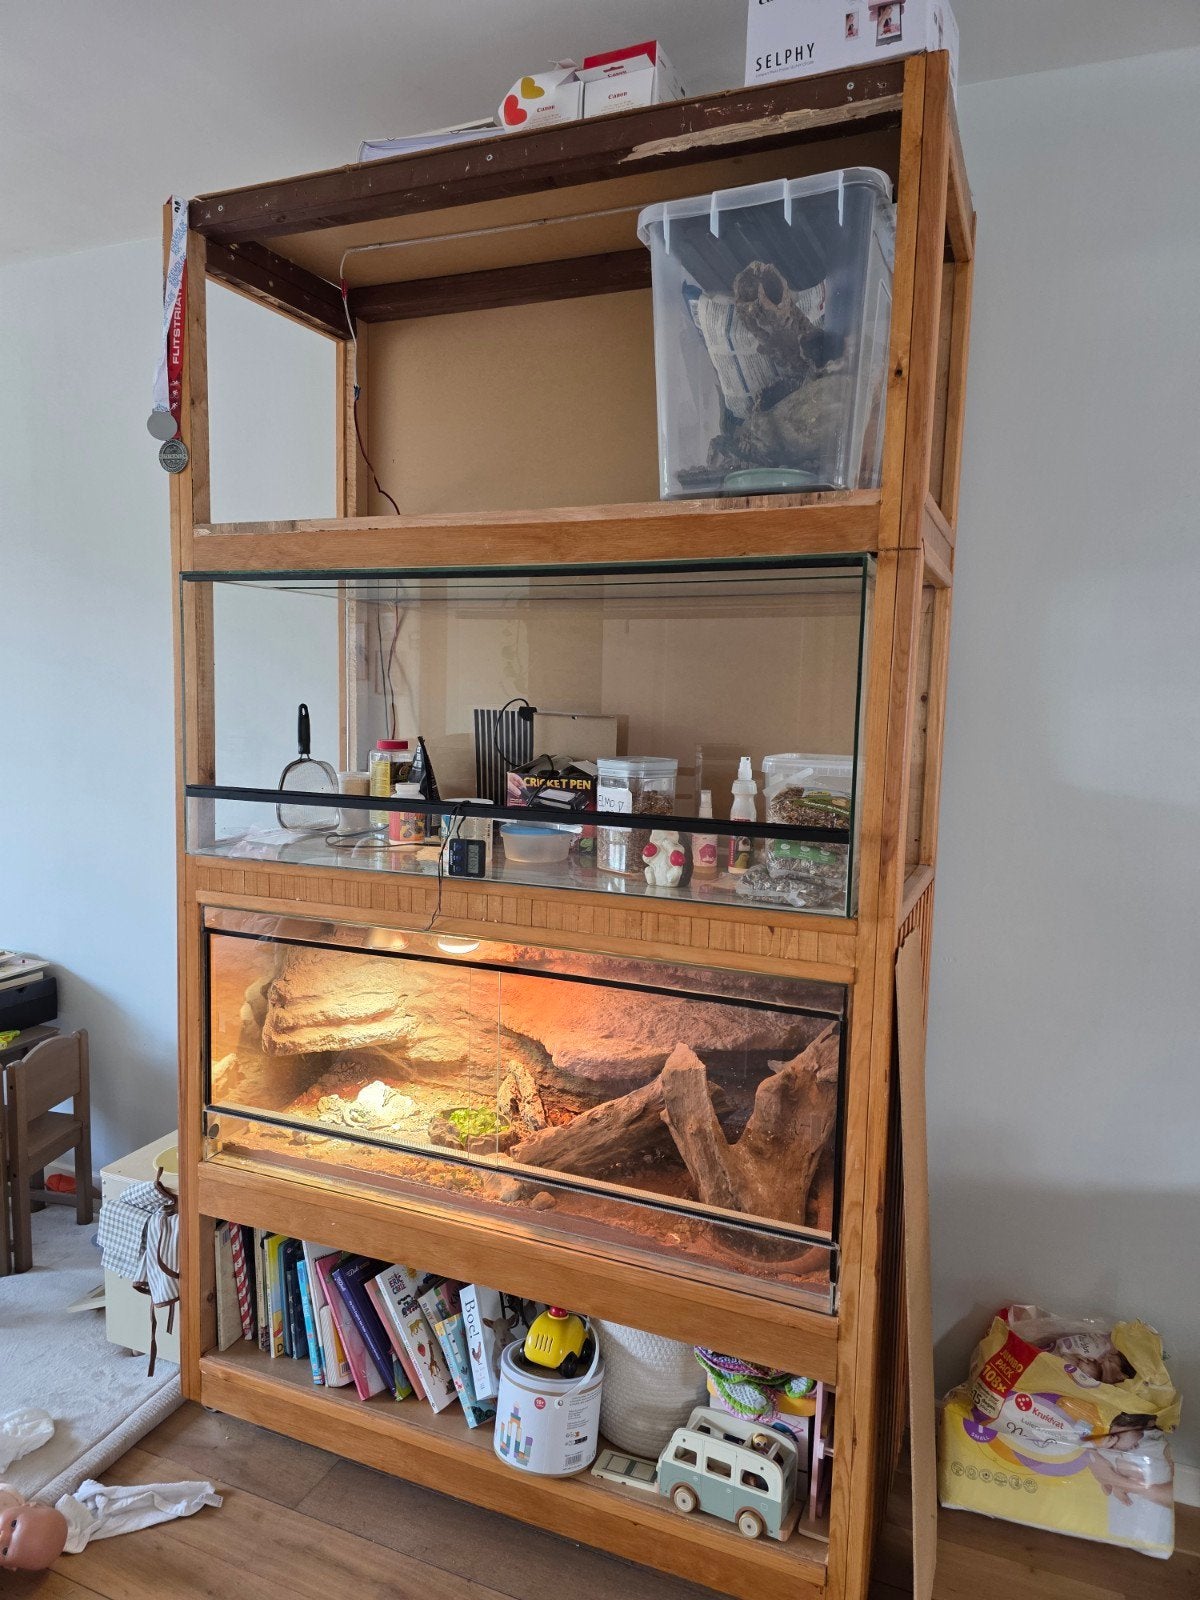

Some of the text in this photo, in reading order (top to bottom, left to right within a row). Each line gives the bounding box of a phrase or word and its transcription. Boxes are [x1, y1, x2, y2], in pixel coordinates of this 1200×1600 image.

[755, 42, 815, 71] SELPHY
[608, 91, 628, 100] Canon
[536, 104, 556, 113] Canon
[570, 779, 591, 790] PEN
[995, 1359, 1014, 1378] PACK
[1000, 1350, 1024, 1373] JUMBO
[982, 1365, 1007, 1393] 108x
[1032, 1407, 1065, 1430] Kruidvat
